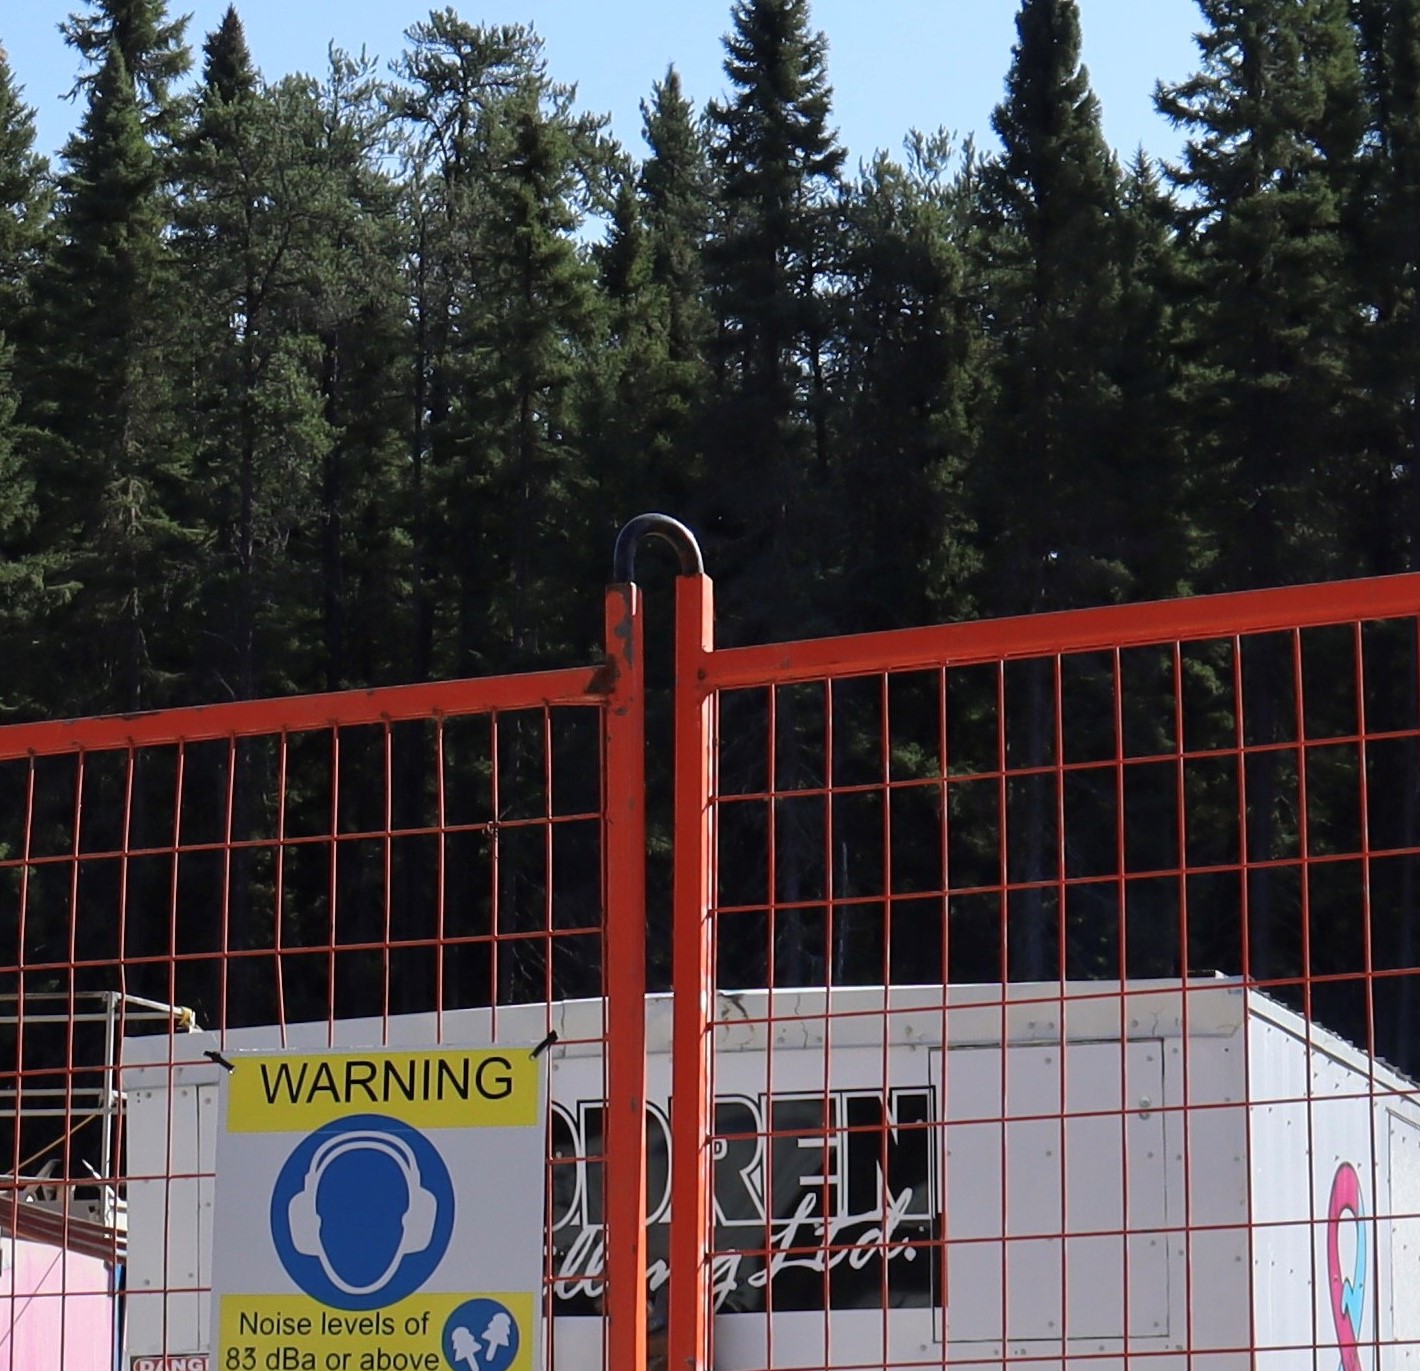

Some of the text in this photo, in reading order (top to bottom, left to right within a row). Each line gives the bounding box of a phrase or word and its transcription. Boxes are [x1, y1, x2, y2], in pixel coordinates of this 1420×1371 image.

[260, 1056, 513, 1104] WARNING
[747, 1188, 917, 1289] Ltd.
[239, 1311, 431, 1336] Noise levels of
[225, 1347, 440, 1371] 83 dBa or above
